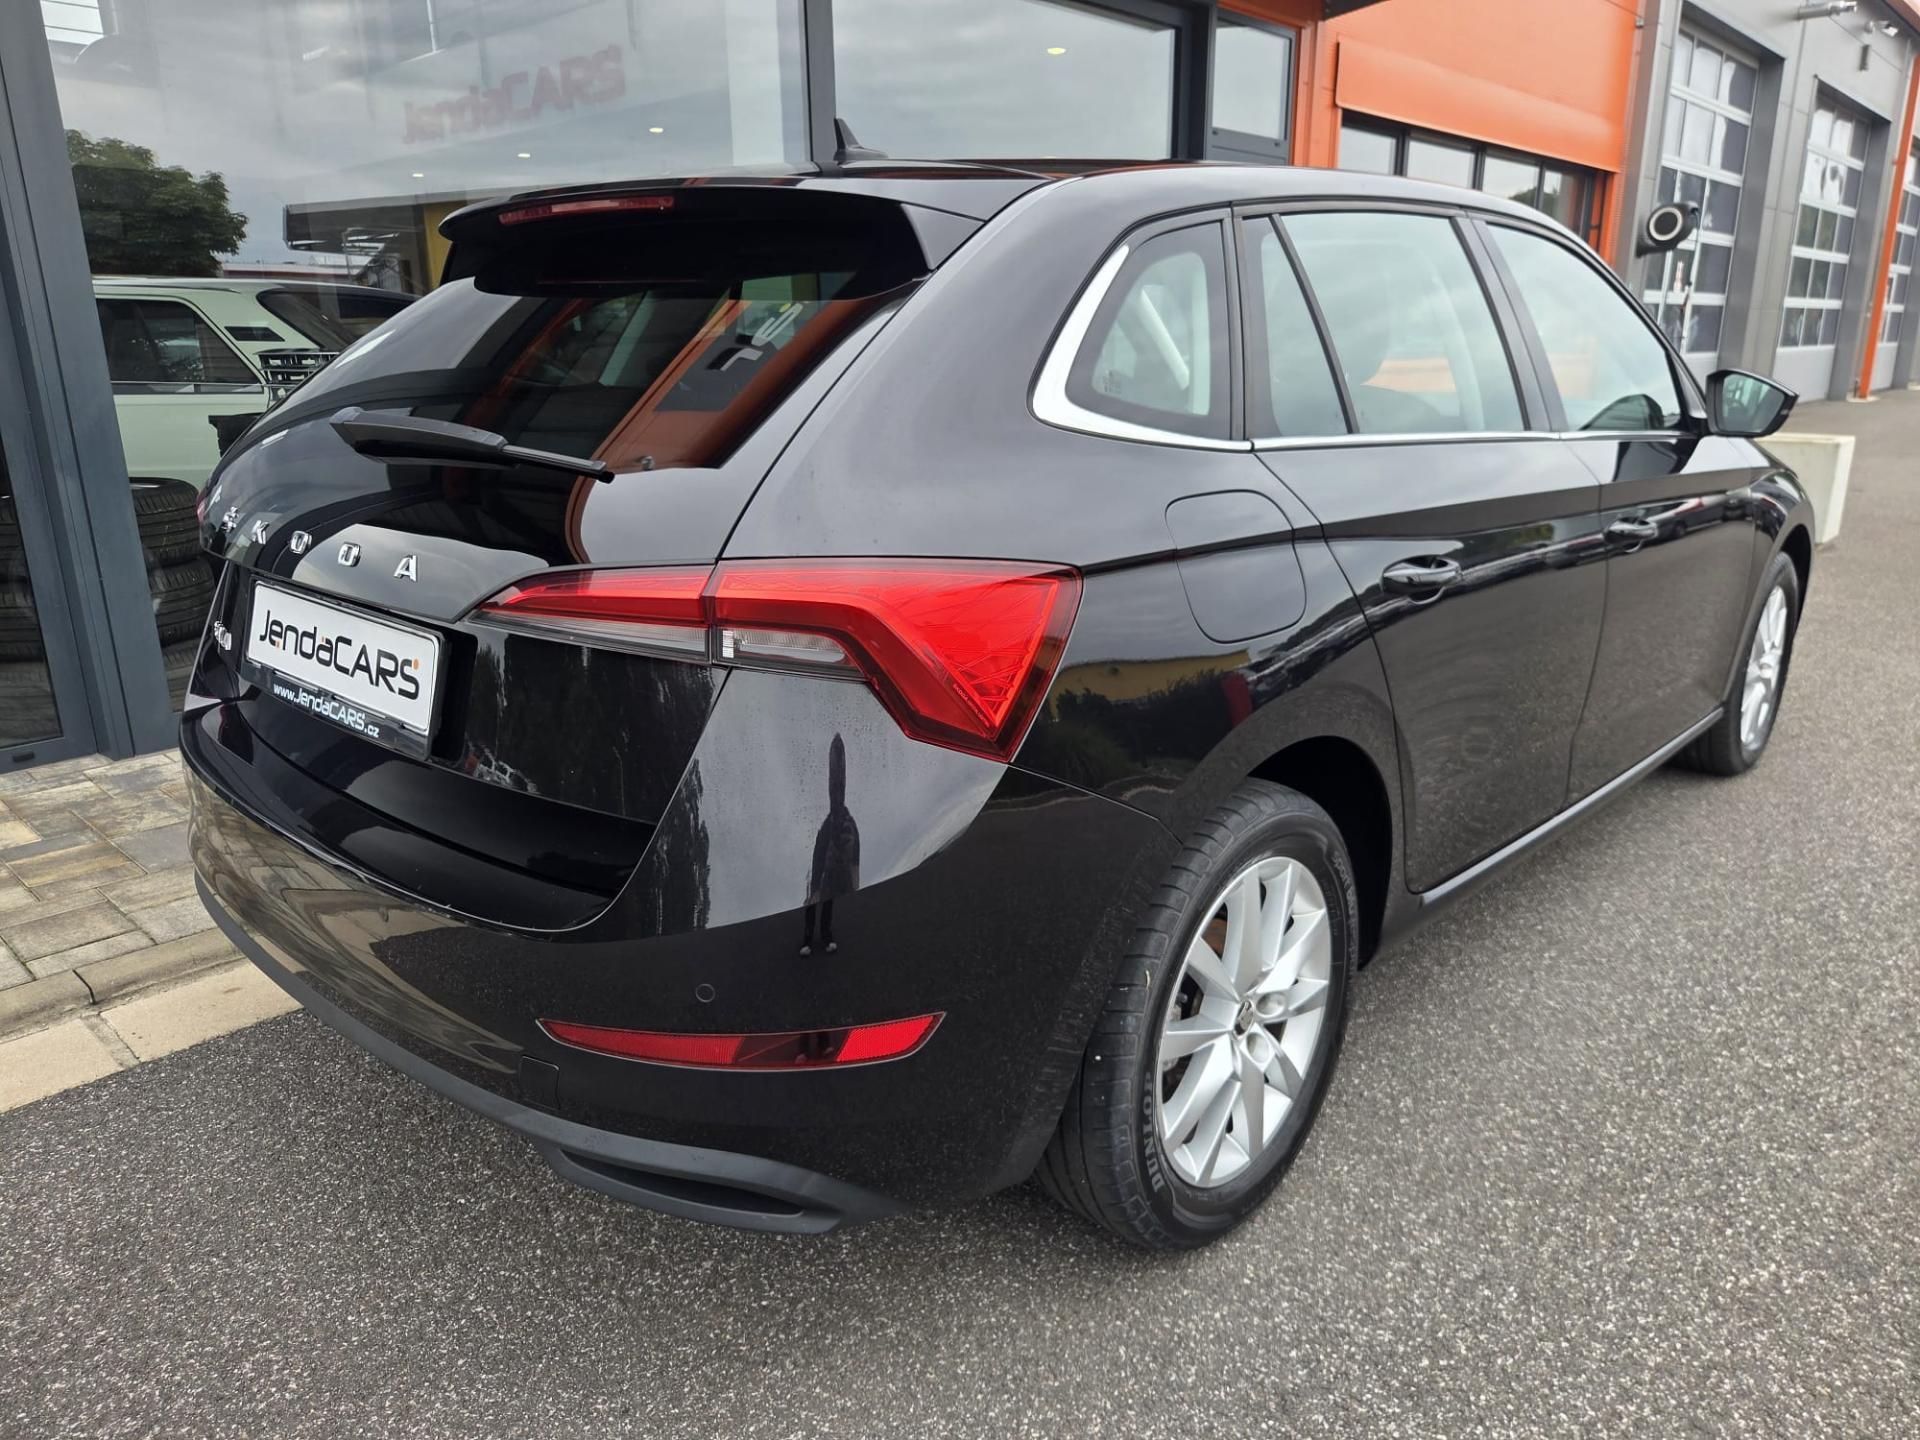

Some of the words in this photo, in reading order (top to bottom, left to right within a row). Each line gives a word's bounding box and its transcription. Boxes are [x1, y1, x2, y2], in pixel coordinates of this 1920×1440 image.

[258, 609, 421, 701] JendaCARS
[273, 683, 380, 738] www.JendaCARS.cz
[1142, 1071, 1166, 1193] DUNLOP
